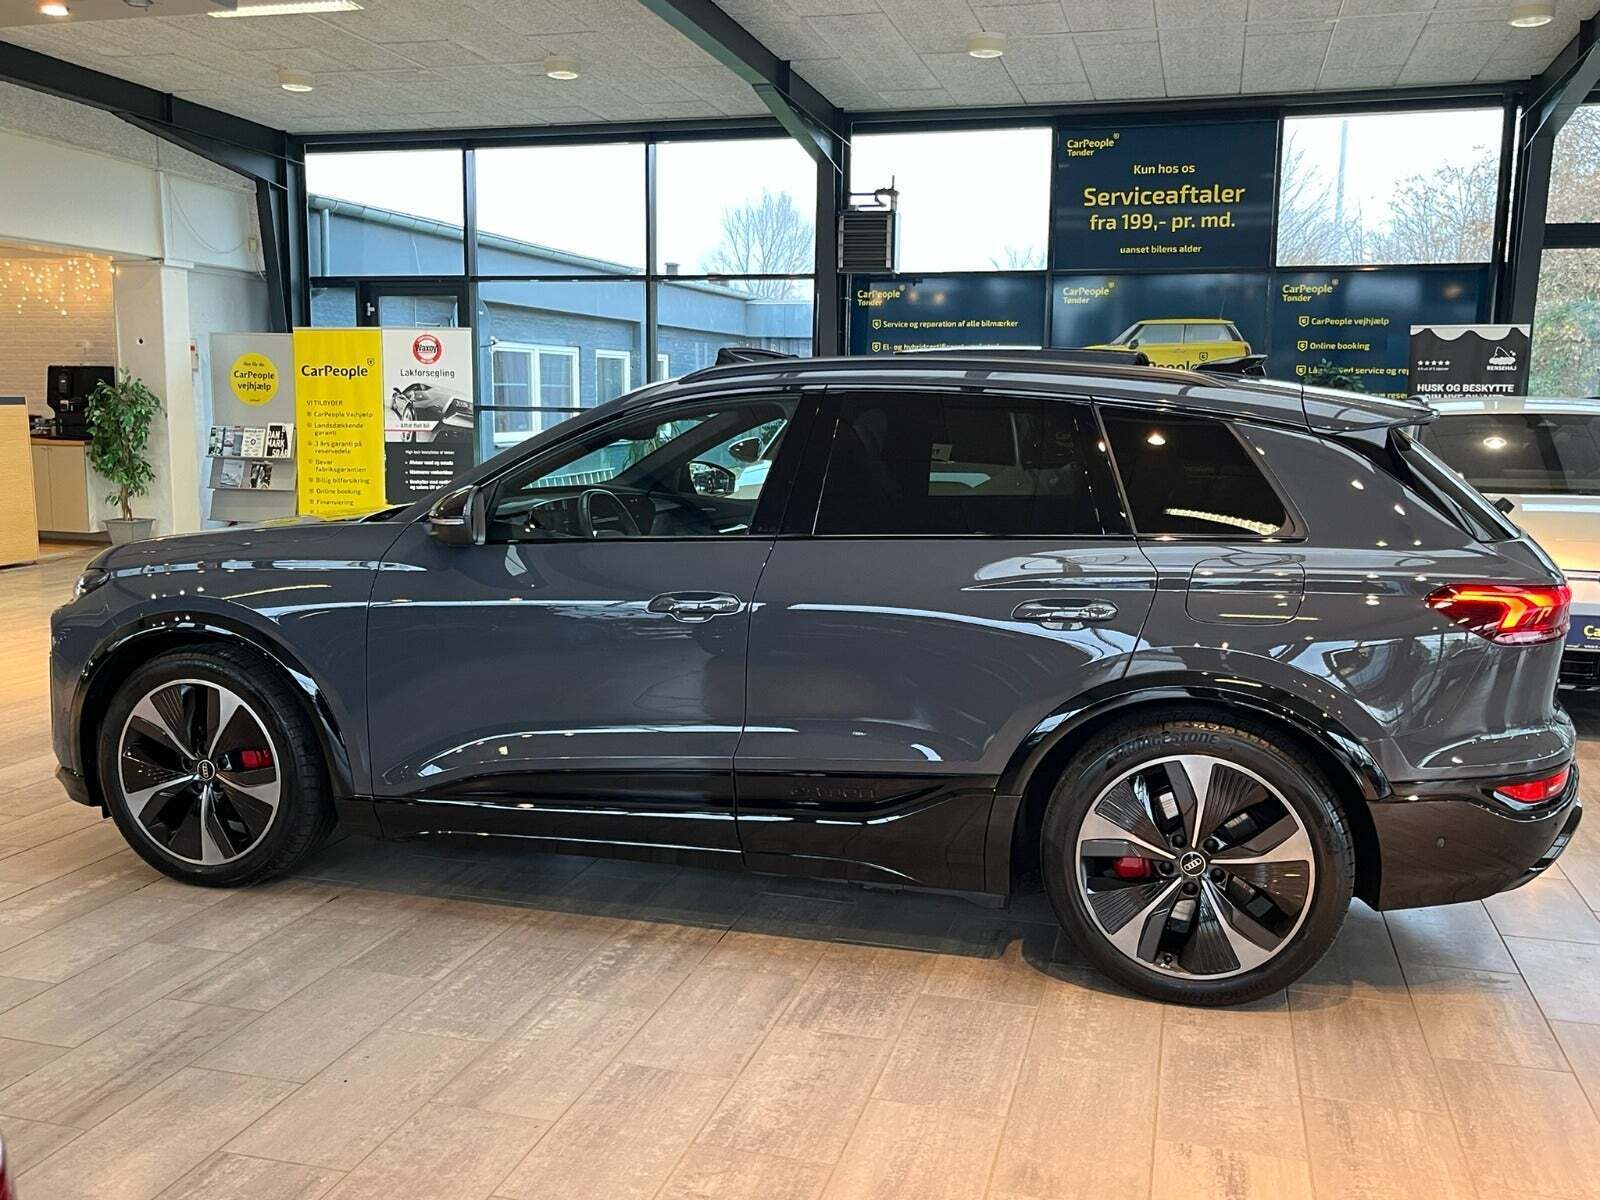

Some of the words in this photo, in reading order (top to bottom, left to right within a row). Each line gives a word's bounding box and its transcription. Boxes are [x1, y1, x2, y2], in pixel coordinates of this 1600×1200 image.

[1067, 137, 1114, 149] CarPeople
[1067, 149, 1095, 157] Tønder
[1133, 164, 1155, 175] Kun
[1158, 163, 1179, 174] hos
[1181, 164, 1195, 174] os
[1083, 184, 1246, 207] Serviceaftaler
[1090, 213, 1117, 231] fra
[1121, 213, 1166, 232] 199,-
[1171, 215, 1195, 232] pr.
[1201, 211, 1236, 228] md.
[1120, 245, 1150, 254] uanset
[1151, 244, 1177, 254] bilens
[1179, 244, 1202, 253] alder
[857, 289, 901, 300] CarPeople
[1063, 287, 1110, 298] CarPeople
[1282, 284, 1333, 296] CarPeople
[1282, 294, 1312, 302] Tønder
[883, 320, 908, 328] Service
[920, 321, 956, 329] reparation
[981, 319, 1018, 327] bilmærker
[1311, 317, 1352, 327] CarPeople
[1354, 317, 1390, 327] vejhjælp
[1310, 341, 1335, 350] Online
[1337, 341, 1370, 351] booking
[233, 370, 275, 380] CarPeople
[301, 365, 368, 380] CarPeople
[400, 368, 455, 378] Lakforsegling
[1355, 367, 1385, 375] service
[1386, 368, 1396, 376] og
[237, 382, 272, 392] vejhjælp
[1417, 384, 1444, 392] HUSK
[1446, 384, 1460, 392] OG
[1462, 384, 1514, 392] BESKYTTE
